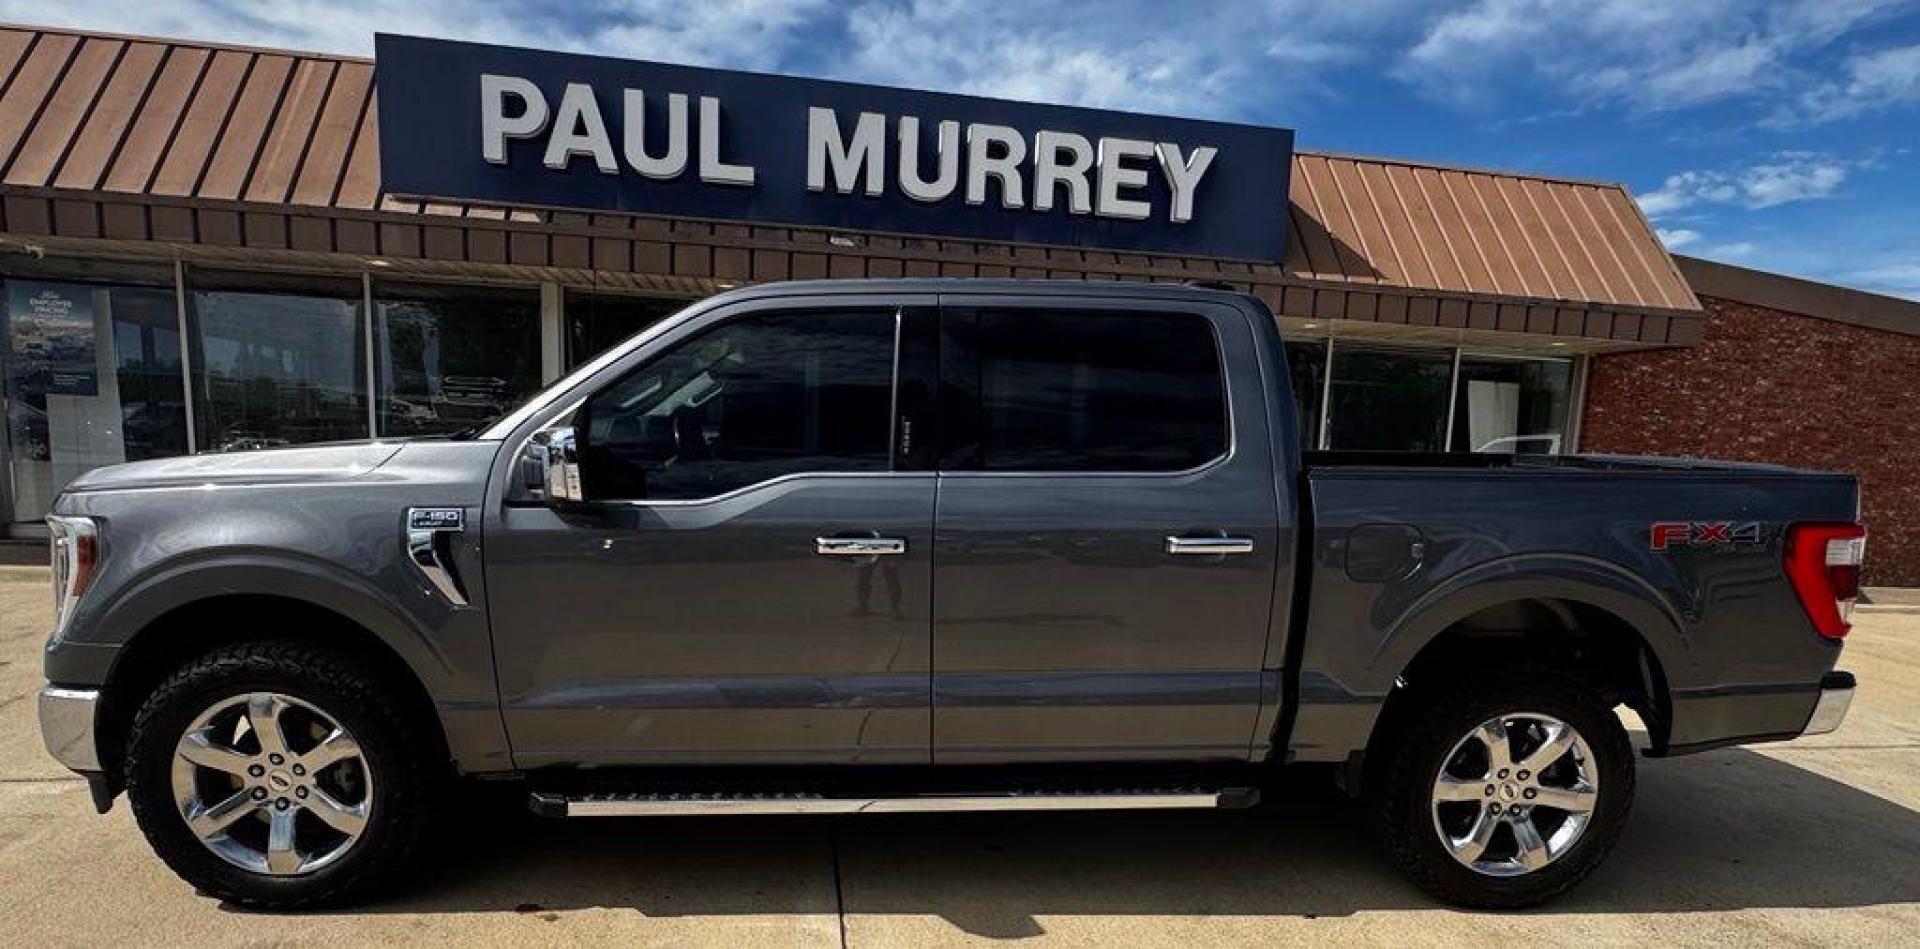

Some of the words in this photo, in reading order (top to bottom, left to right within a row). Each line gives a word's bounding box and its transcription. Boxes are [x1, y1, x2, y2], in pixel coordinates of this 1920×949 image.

[480, 74, 755, 186] PAUL
[807, 106, 1218, 223] MURREY
[413, 511, 458, 521] F-150
[1650, 521, 1767, 551] FX4
